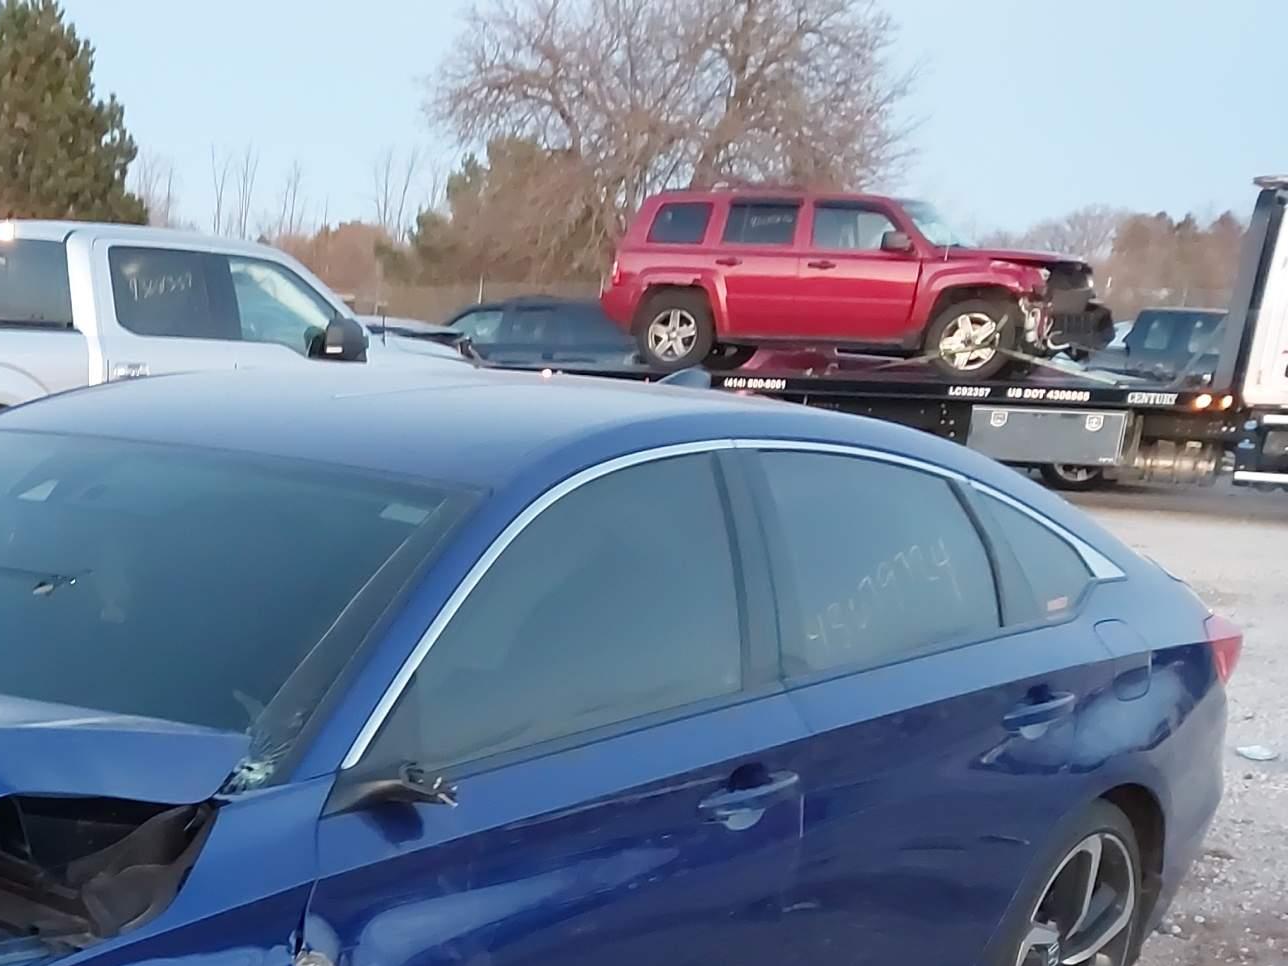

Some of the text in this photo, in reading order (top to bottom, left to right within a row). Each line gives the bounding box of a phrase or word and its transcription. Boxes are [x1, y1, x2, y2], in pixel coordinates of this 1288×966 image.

[1007, 386, 1022, 398] US
[1024, 388, 1045, 399] DOT
[1127, 391, 1179, 405] CENTURY
